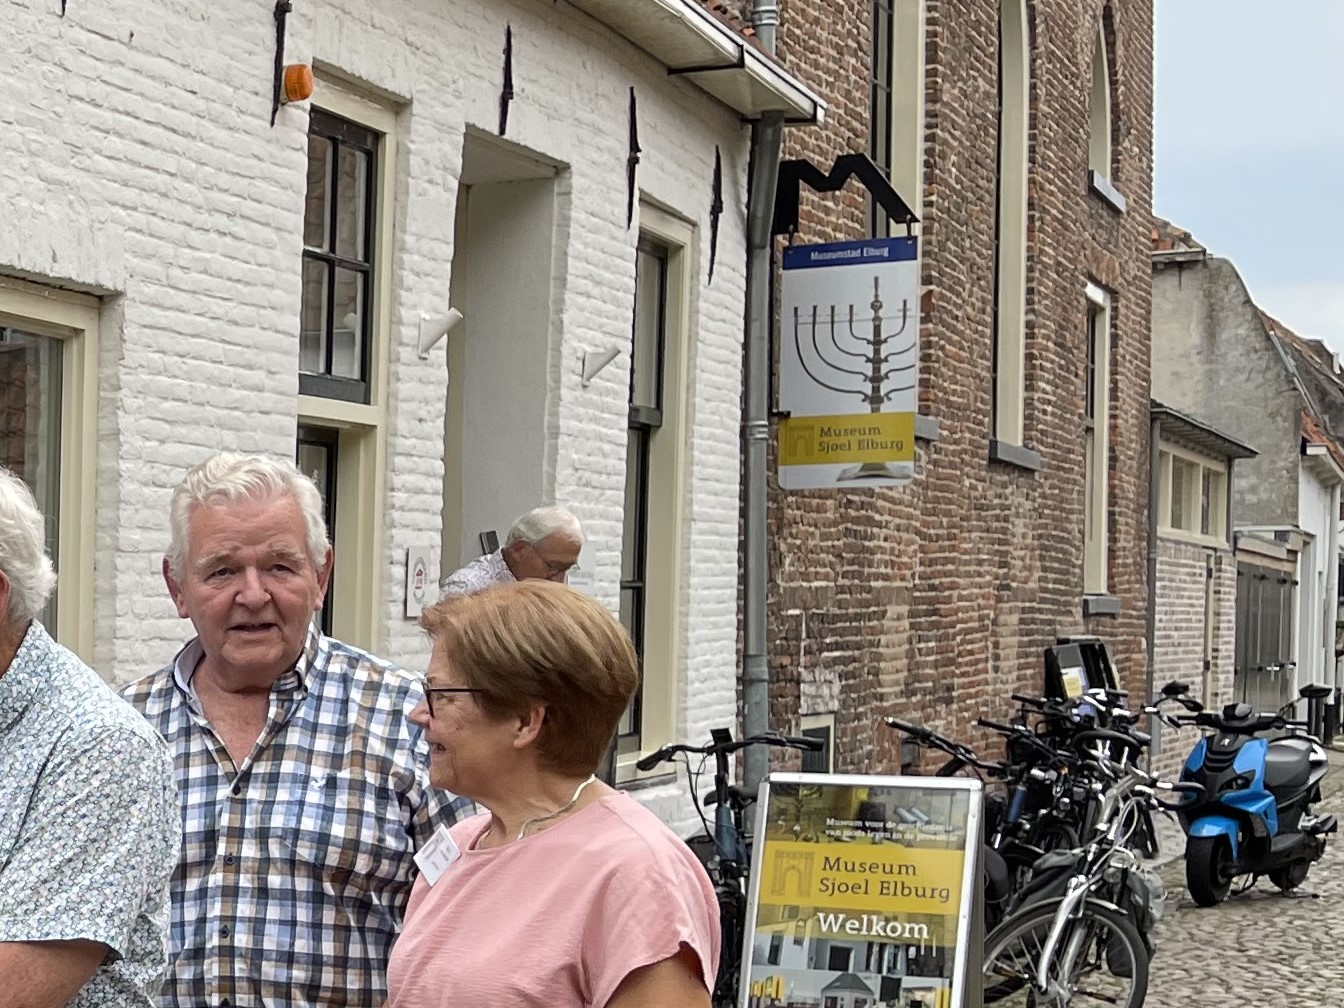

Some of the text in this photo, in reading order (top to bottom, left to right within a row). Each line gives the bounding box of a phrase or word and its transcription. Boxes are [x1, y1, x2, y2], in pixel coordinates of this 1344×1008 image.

[863, 247, 889, 257] Elburg
[819, 426, 881, 437] Museum
[818, 439, 904, 454] Sjoel Elburg
[821, 856, 918, 876] Museum
[819, 877, 951, 904] Sjoel Elburg
[817, 912, 930, 939] Welkom
